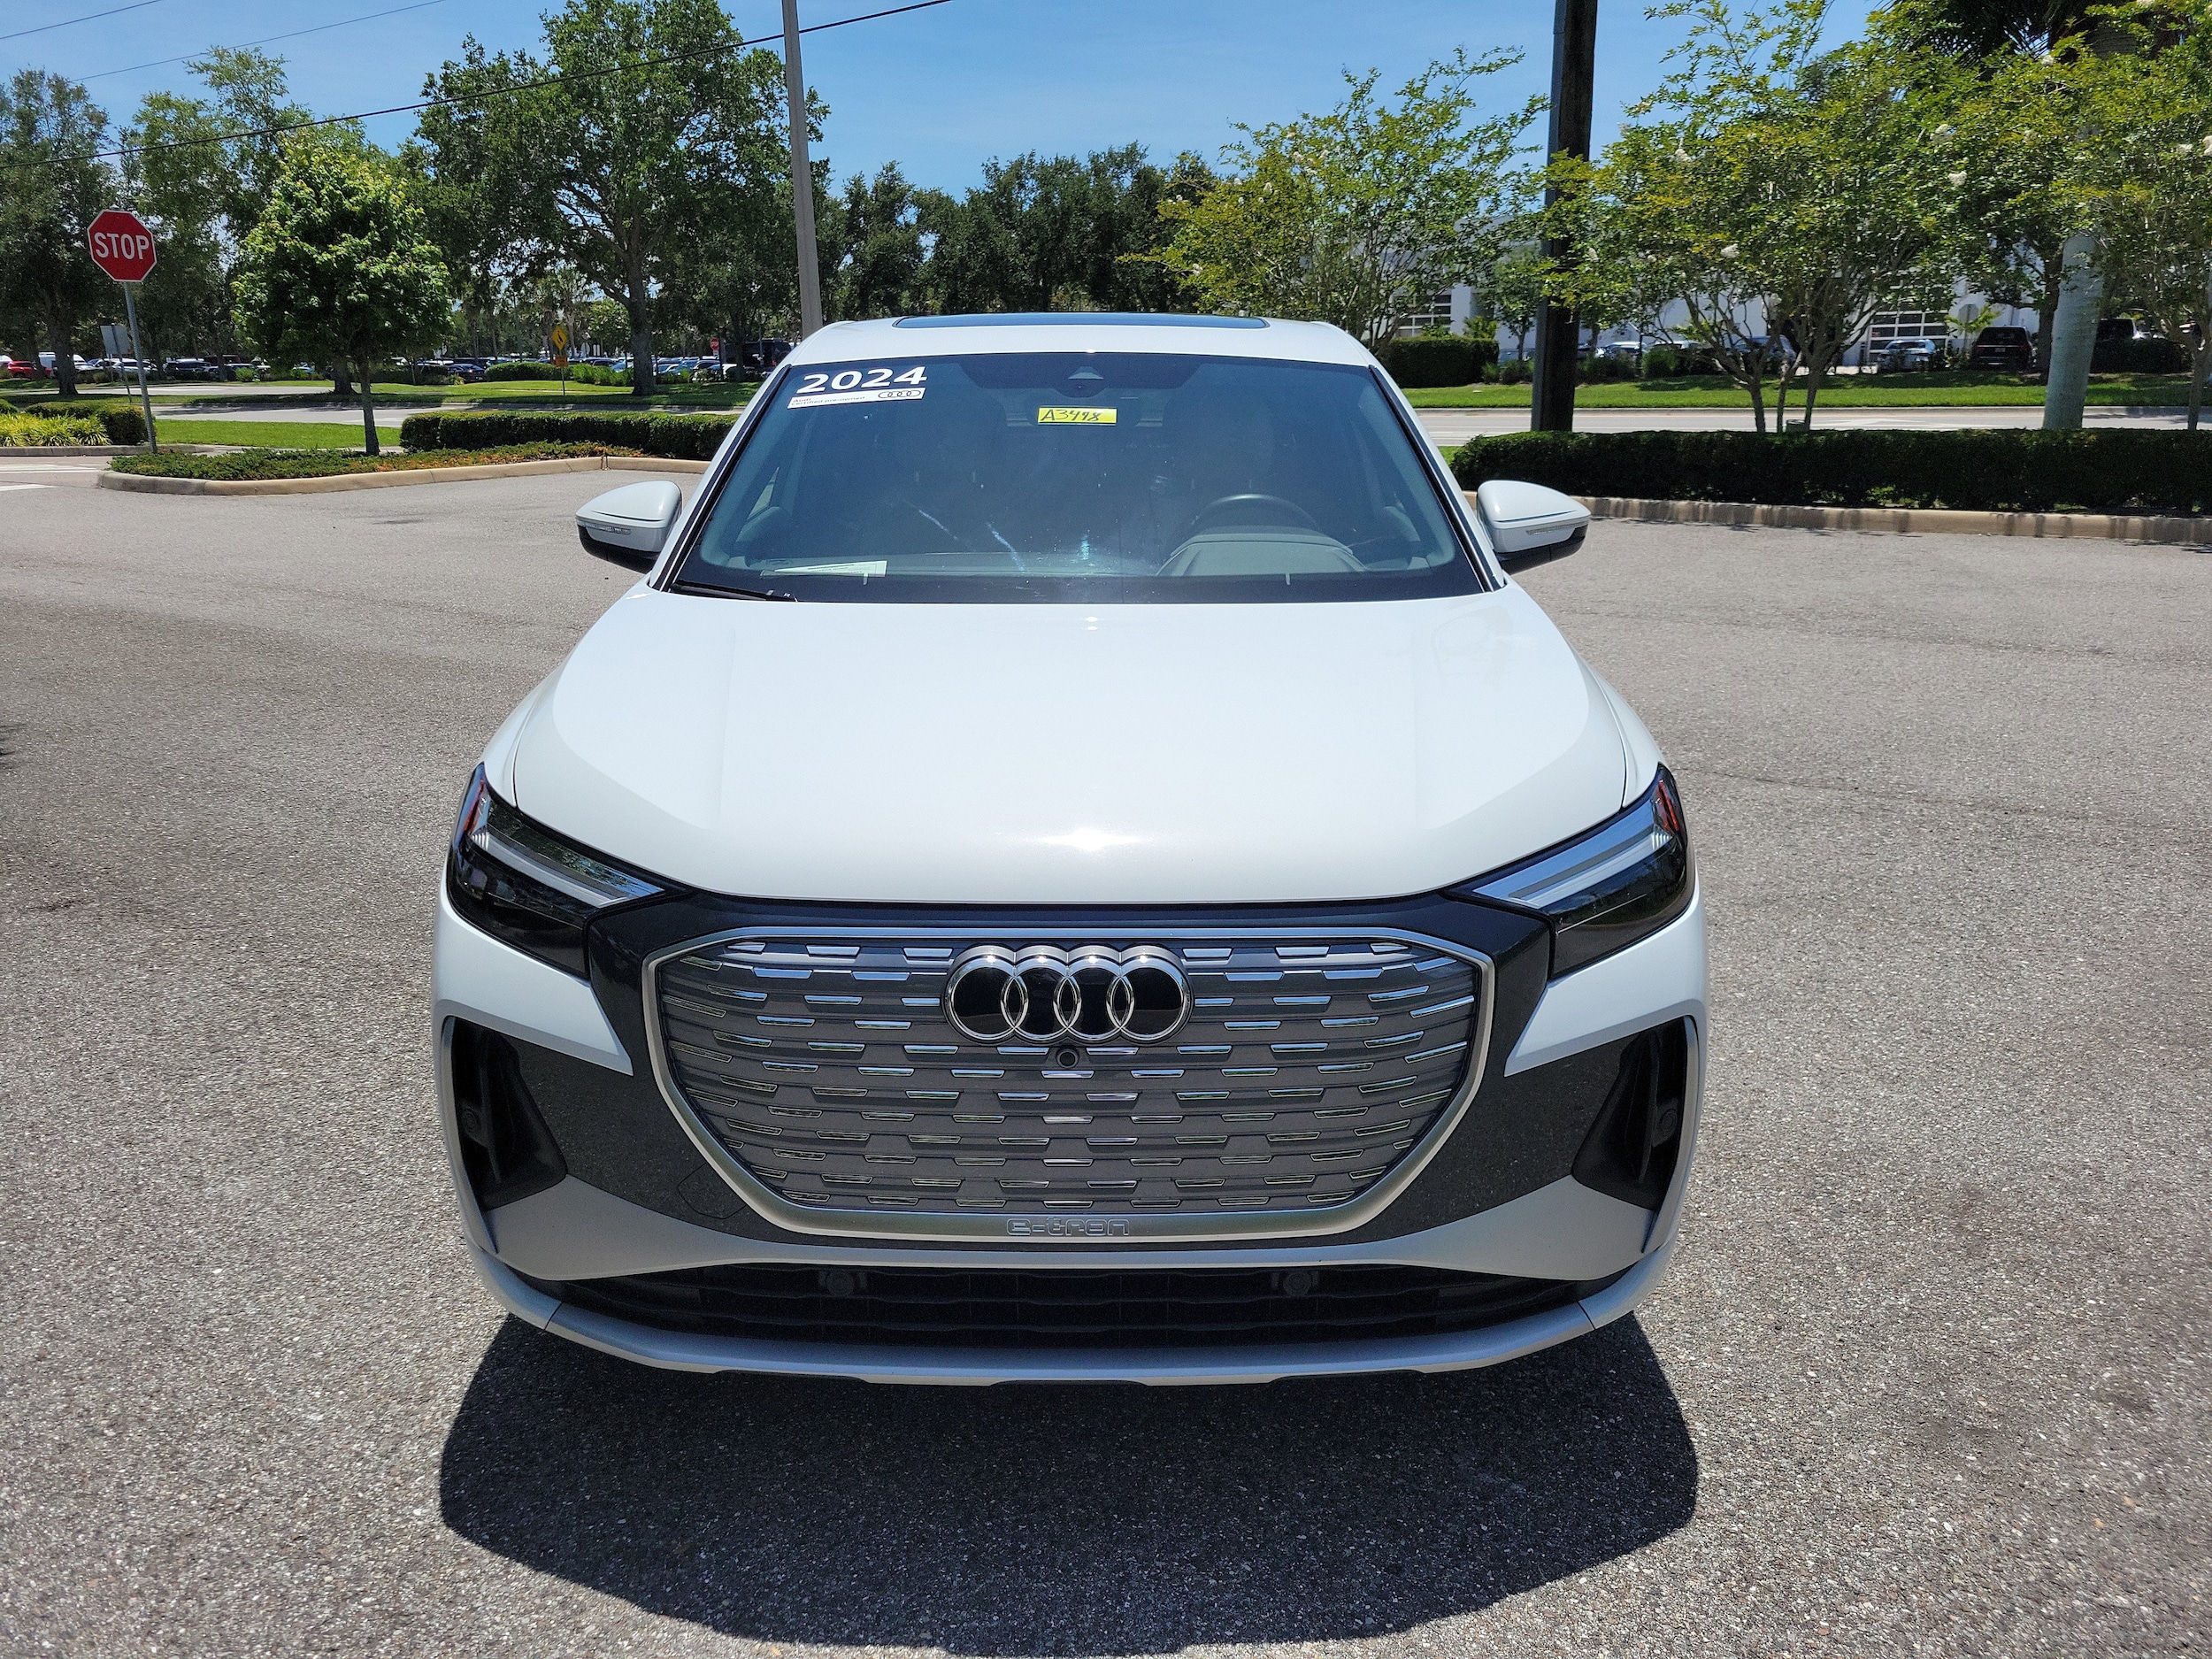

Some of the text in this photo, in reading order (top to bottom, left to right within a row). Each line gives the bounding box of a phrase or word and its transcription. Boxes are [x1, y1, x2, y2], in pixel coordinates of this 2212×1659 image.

[94, 232, 150, 260] STOP
[796, 366, 928, 394] 2024
[1006, 1217, 1130, 1236] e-tron
